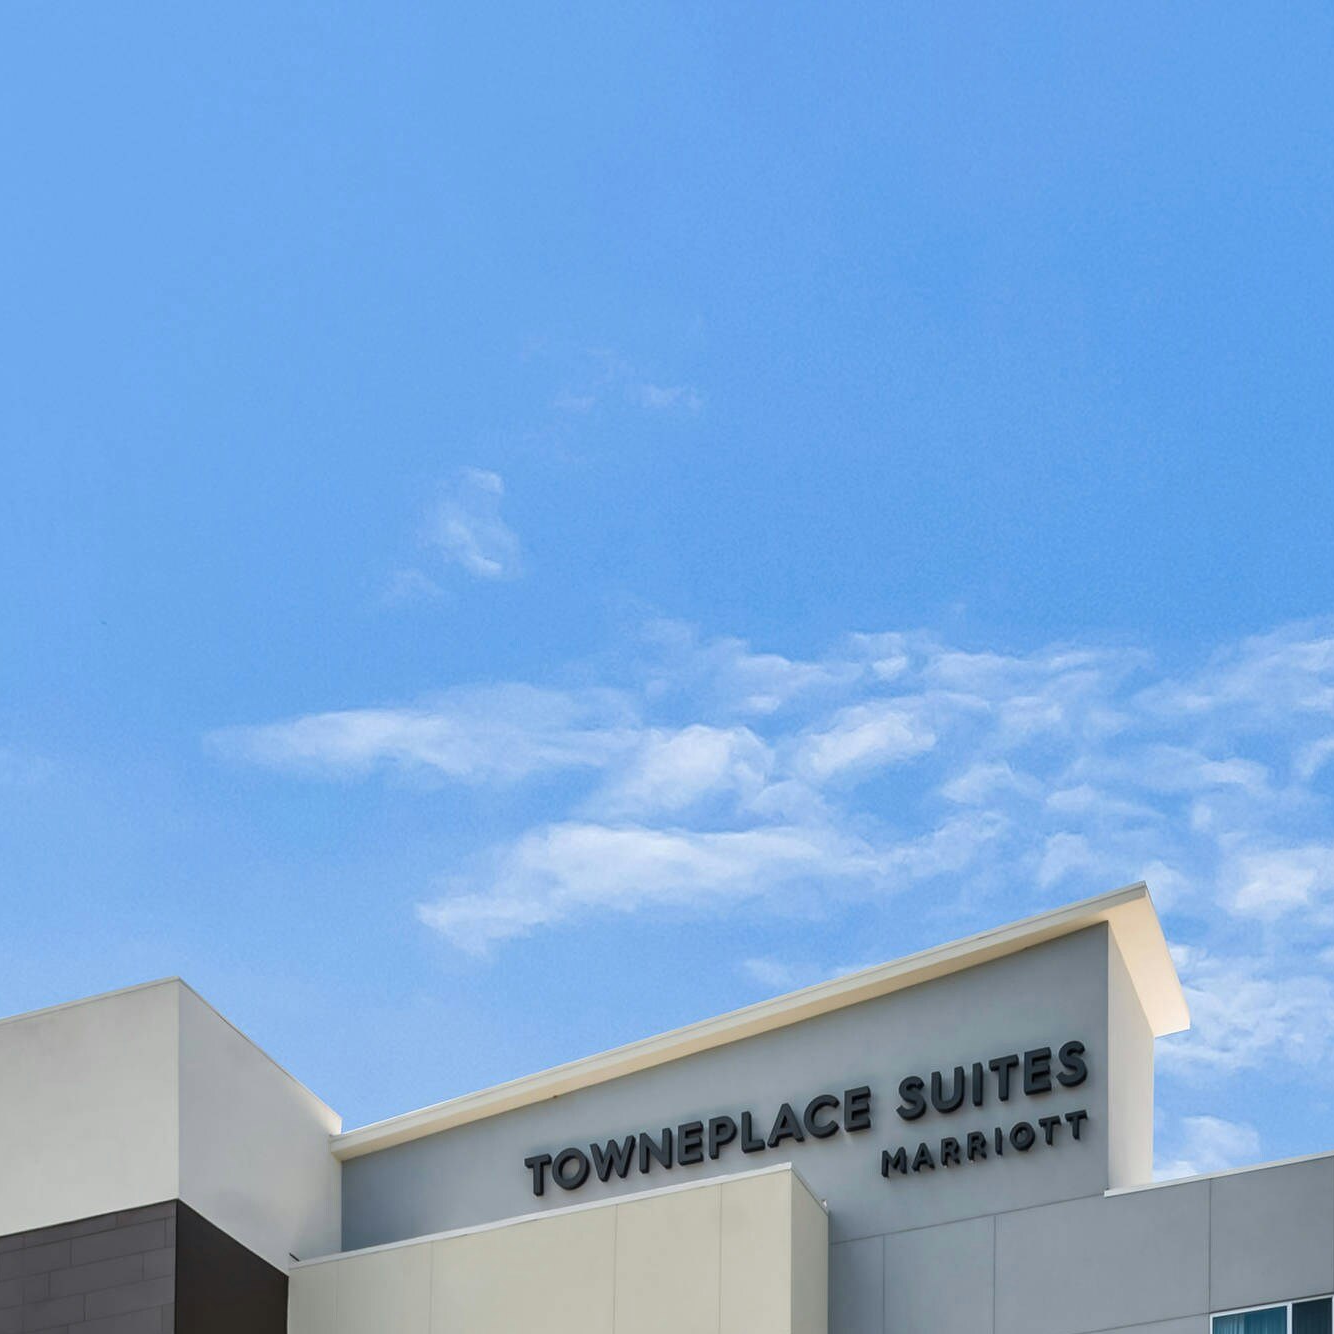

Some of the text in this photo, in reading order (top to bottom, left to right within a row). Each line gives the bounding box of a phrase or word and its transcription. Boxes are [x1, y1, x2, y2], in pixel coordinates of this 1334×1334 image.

[524, 1040, 1088, 1196] TOWNEPLACE SUITES
[881, 1109, 1088, 1178] MARRIOTT
